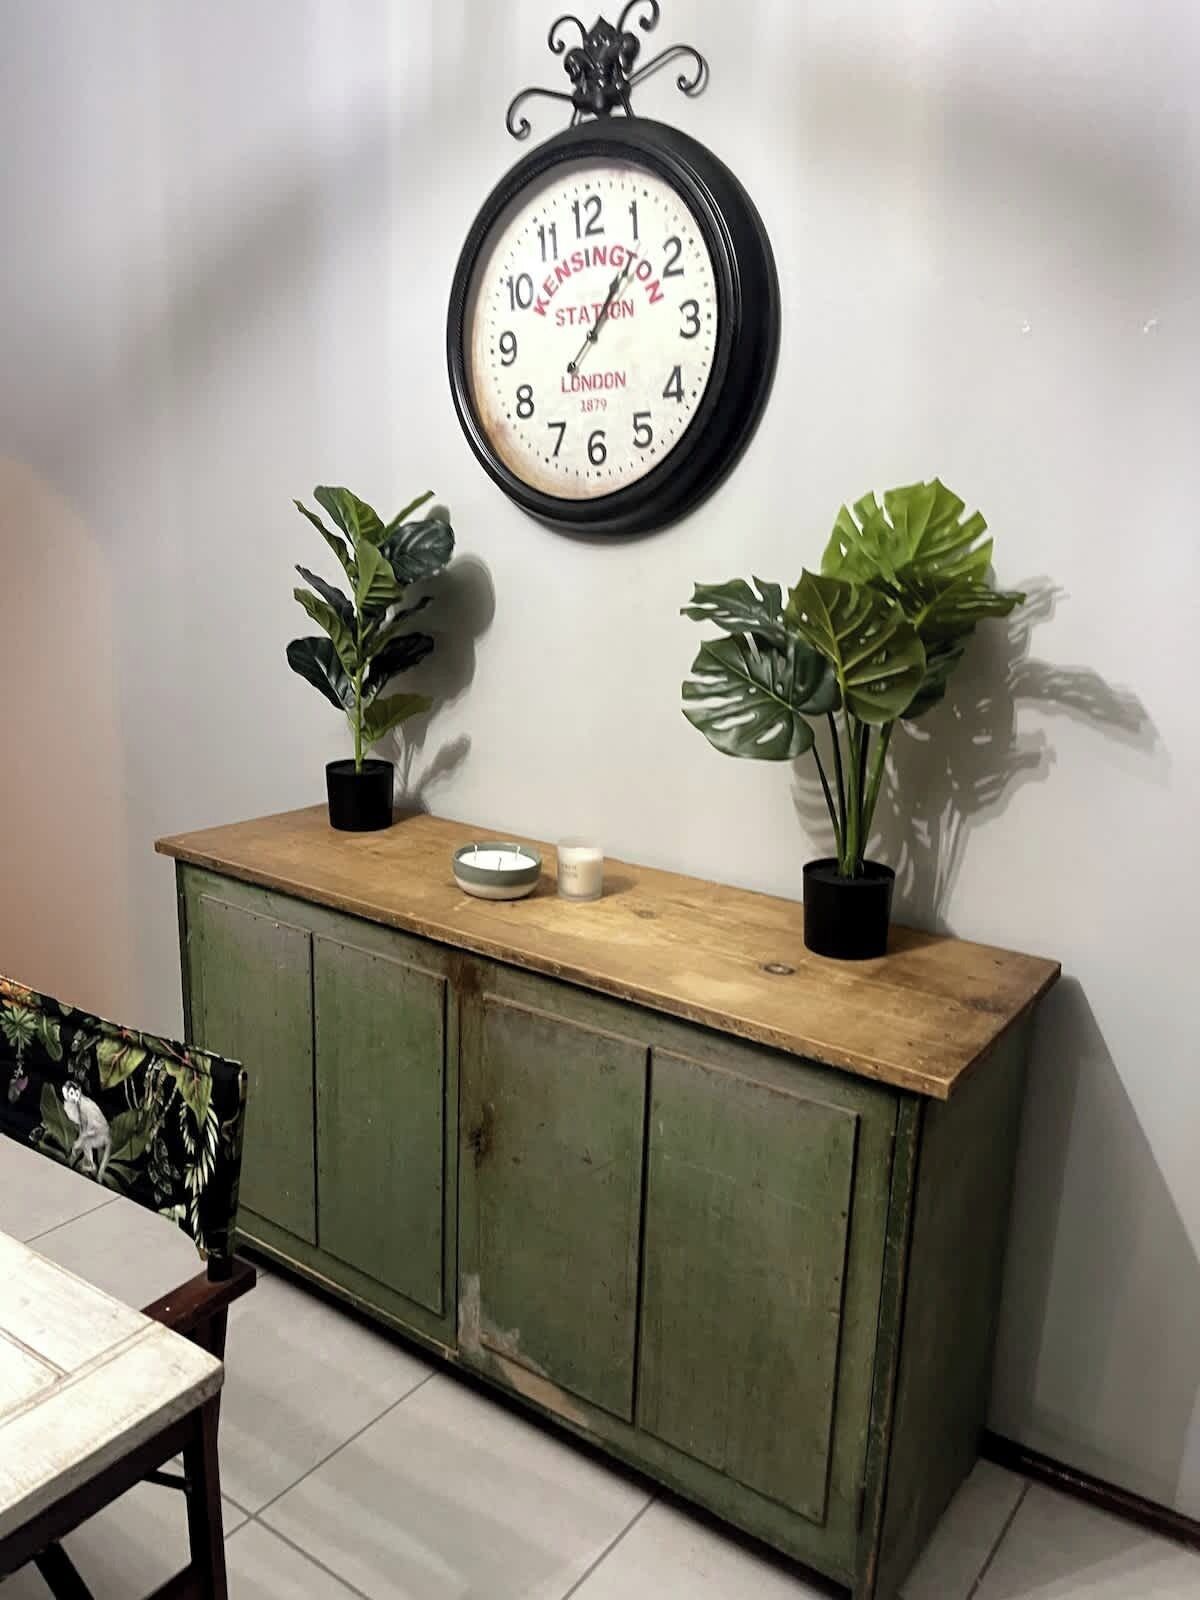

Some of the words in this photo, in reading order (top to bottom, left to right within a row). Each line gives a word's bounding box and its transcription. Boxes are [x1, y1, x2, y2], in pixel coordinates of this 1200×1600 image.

[571, 195, 605, 239] 12
[628, 199, 639, 240] 1
[537, 221, 559, 262] 11
[662, 236, 684, 278] 2
[506, 272, 534, 311] 10
[533, 245, 664, 317] KENSINGTON
[679, 299, 701, 339] 3
[499, 330, 518, 366] 9
[561, 371, 626, 393] LONDON
[662, 365, 685, 403] 4
[516, 384, 535, 419] 8
[580, 397, 607, 413] 1879
[547, 422, 566, 457] 7
[587, 430, 607, 466] 6
[632, 411, 653, 448] 5
